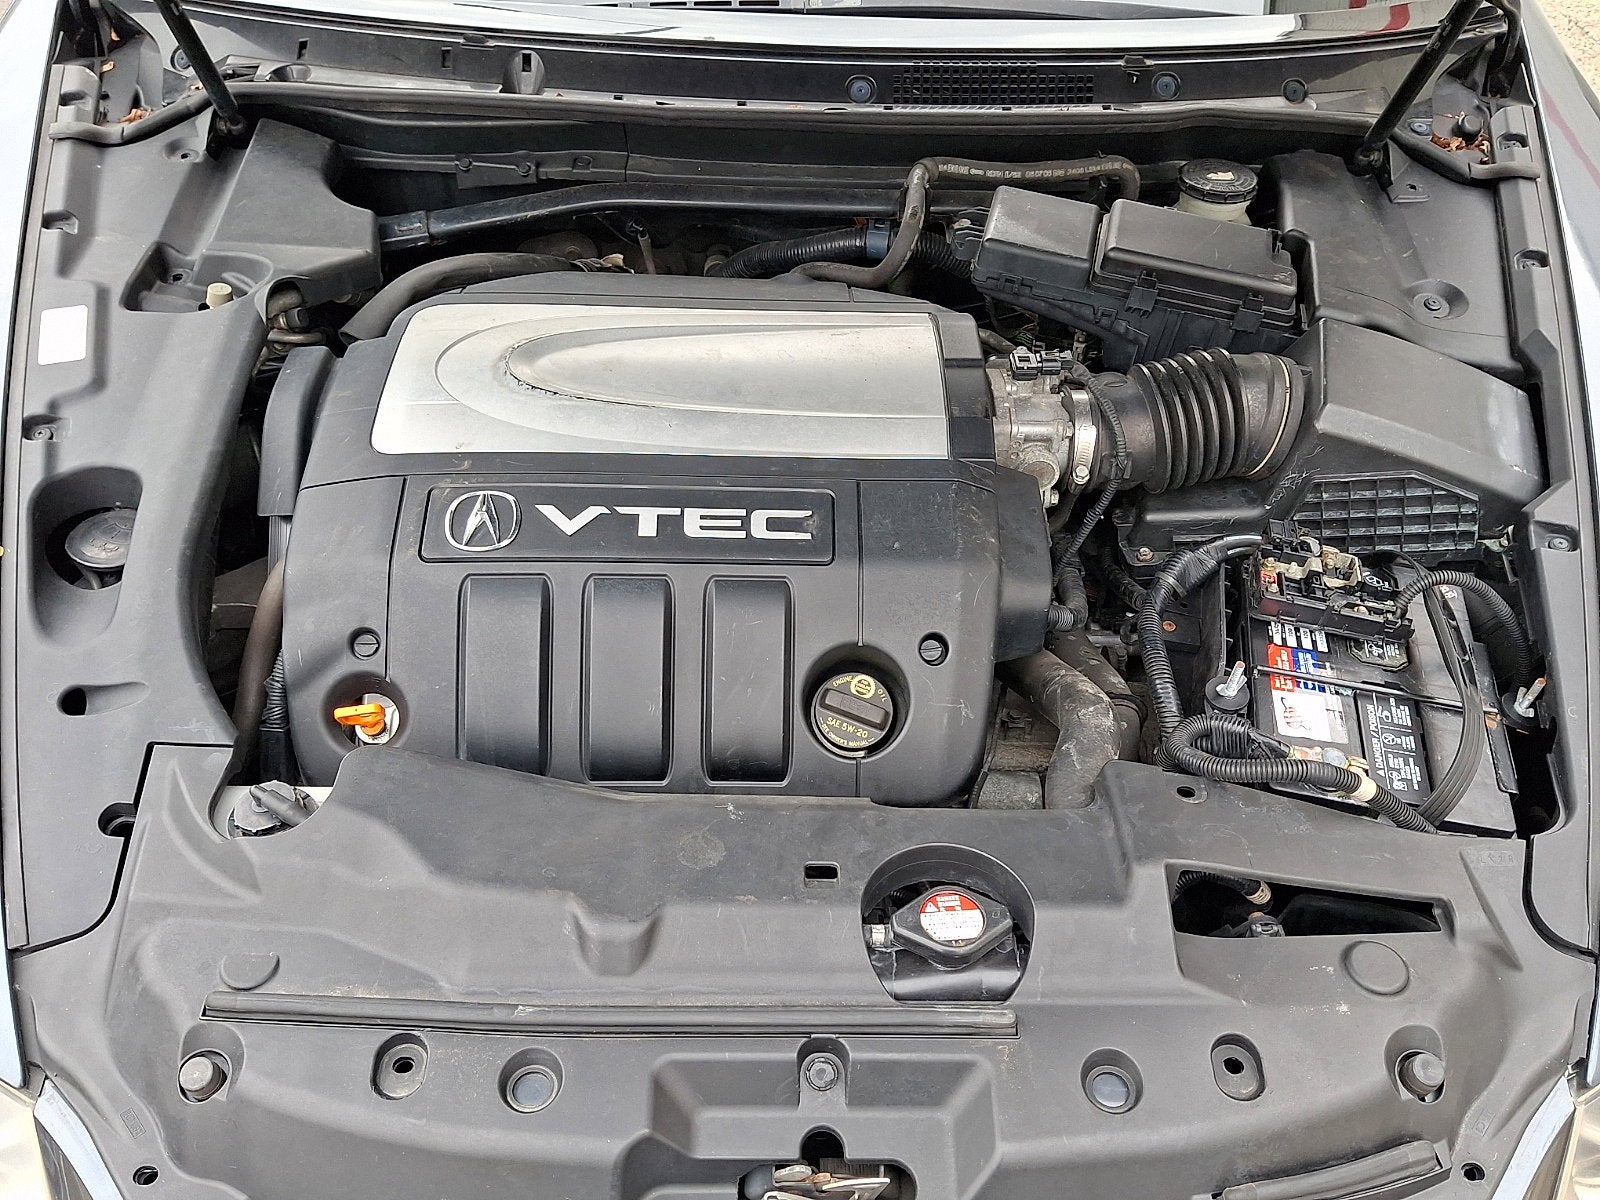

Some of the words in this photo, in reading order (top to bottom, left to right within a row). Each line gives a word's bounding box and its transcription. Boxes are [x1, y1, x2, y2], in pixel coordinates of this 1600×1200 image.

[534, 504, 813, 540] VTEC
[833, 675, 853, 686] ENGINE
[877, 688, 888, 703] OIL
[827, 717, 841, 728] SAE
[841, 722, 868, 738] 5W-20
[1366, 704, 1379, 731] POISON
[1371, 737, 1384, 769] DANGER
